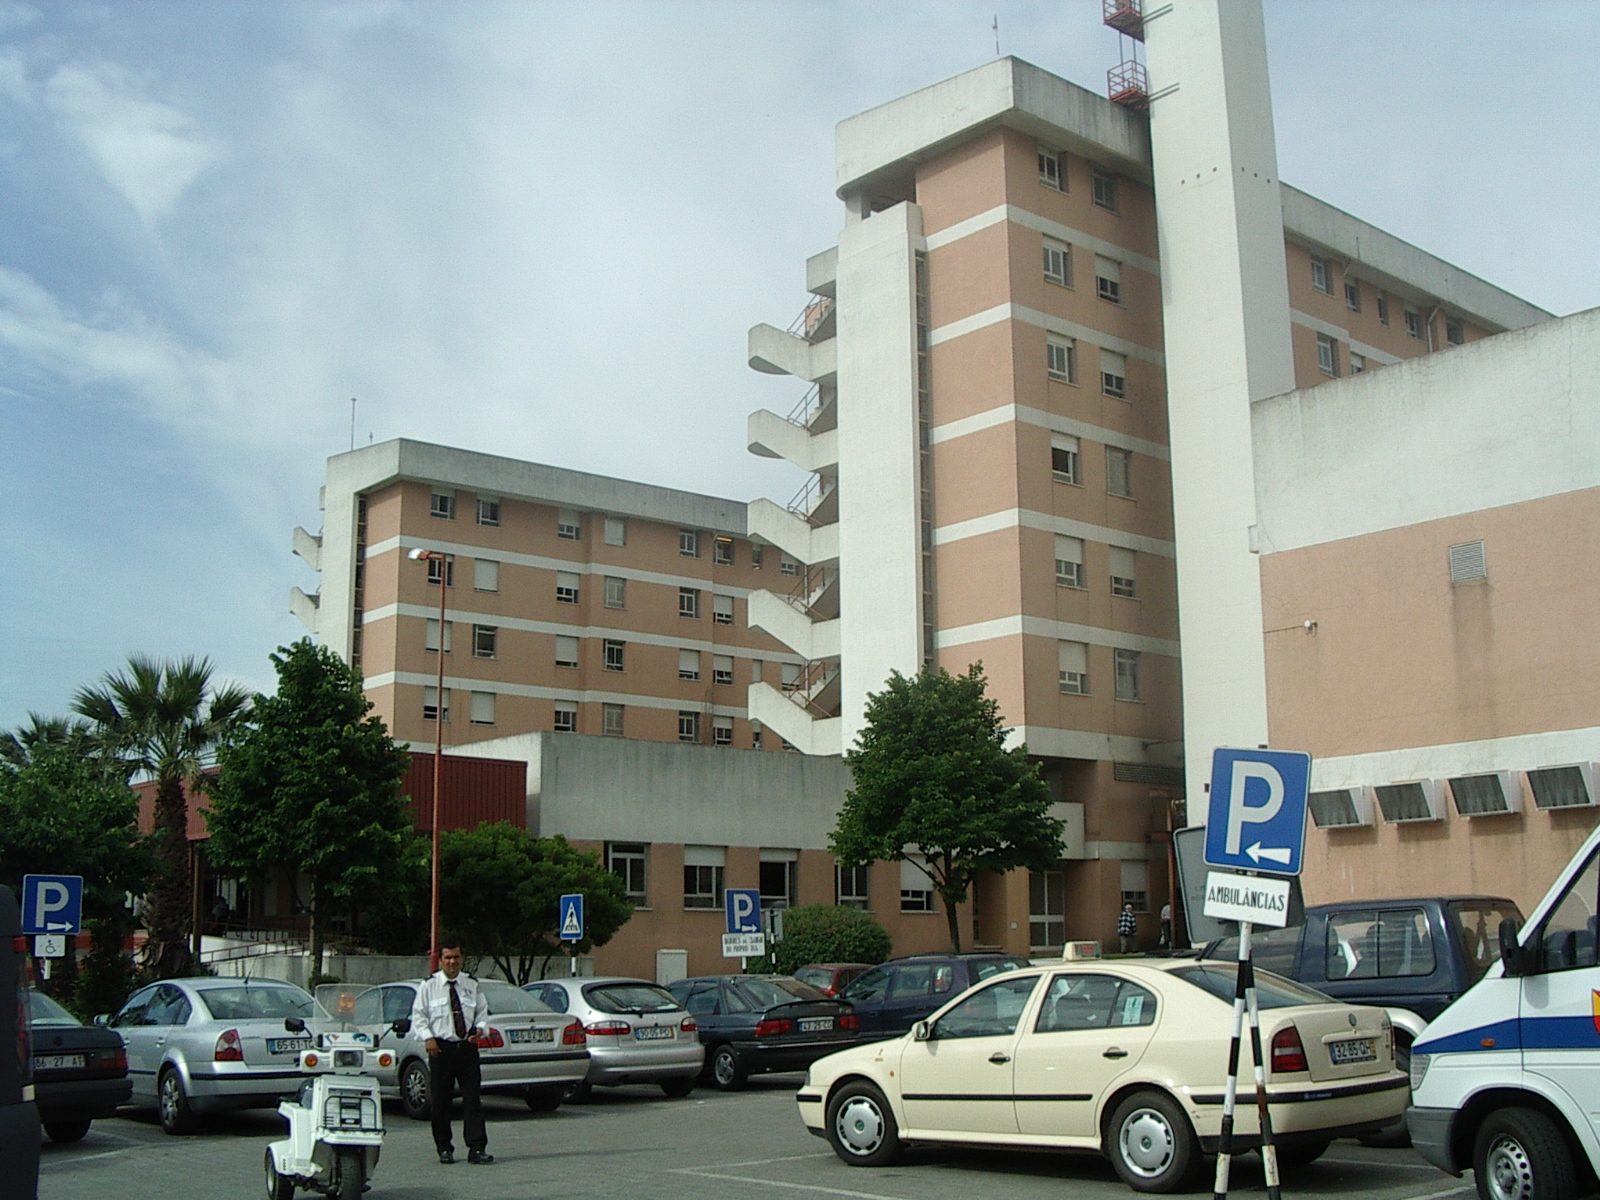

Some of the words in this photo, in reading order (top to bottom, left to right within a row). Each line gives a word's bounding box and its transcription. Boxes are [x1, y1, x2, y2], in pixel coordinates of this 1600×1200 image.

[1225, 760, 1285, 855] P
[35, 881, 70, 928] P
[733, 893, 753, 930] P
[1207, 885, 1285, 912] AMBULÂNCIAS
